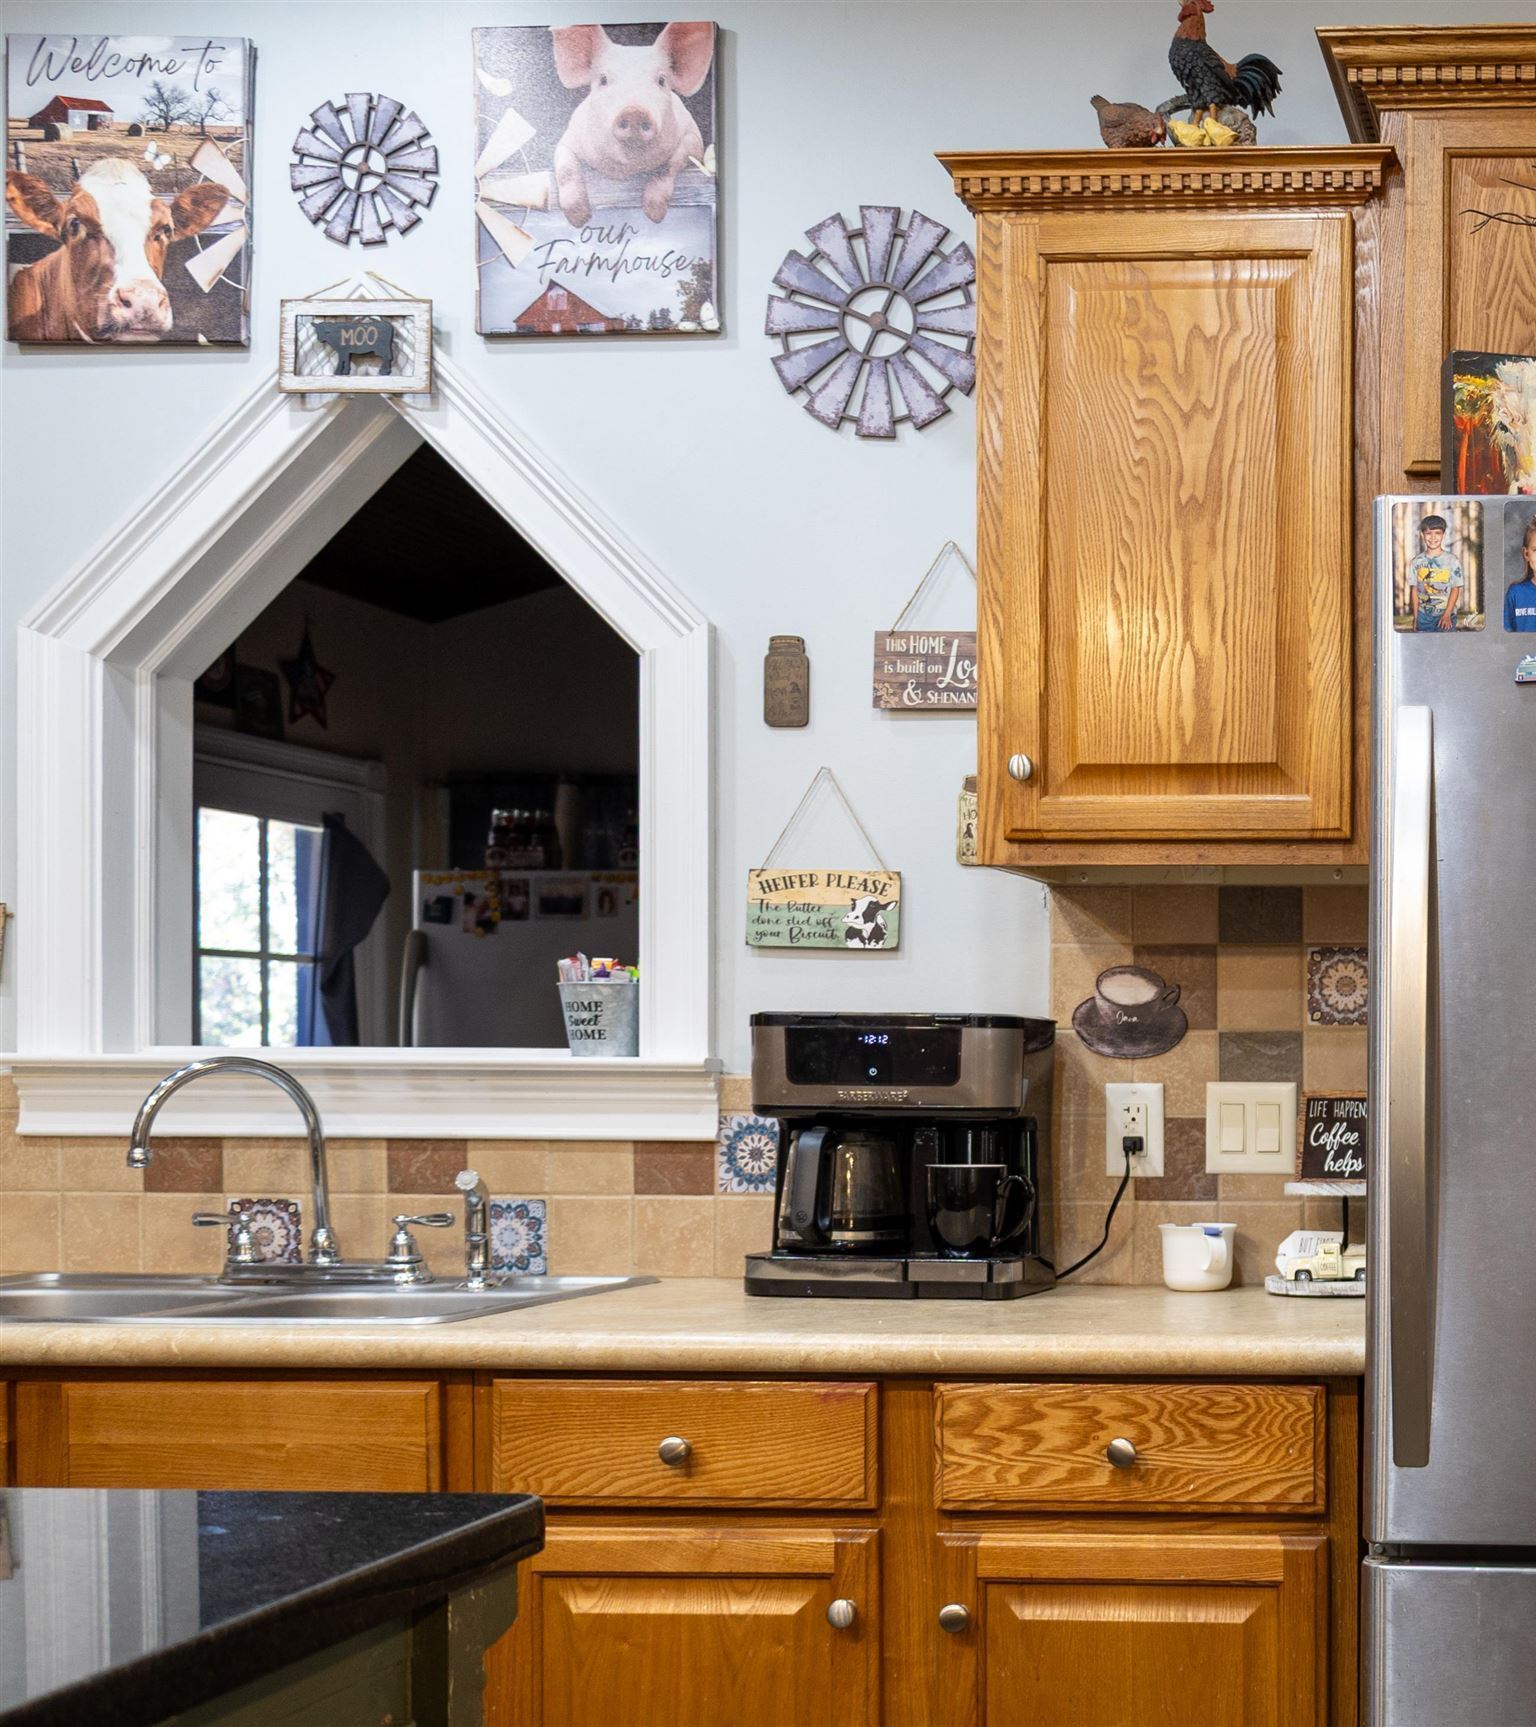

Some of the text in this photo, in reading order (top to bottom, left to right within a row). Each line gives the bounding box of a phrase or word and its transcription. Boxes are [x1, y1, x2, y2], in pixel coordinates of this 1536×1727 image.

[26, 36, 226, 92] Welcome to
[580, 222, 640, 245] our
[534, 239, 697, 285] Farmhouse
[341, 326, 378, 346] MOO
[885, 635, 947, 655] THIS HOME
[884, 661, 894, 674] is
[896, 659, 925, 674] built
[927, 664, 942, 673] on
[903, 679, 977, 706] & SHENAN
[758, 873, 893, 897] HEIFER PLEASE
[752, 898, 782, 914] The
[752, 915, 839, 928] done slid off
[753, 929, 783, 942] your
[565, 1001, 603, 1012] HOME
[568, 1013, 602, 1026] Sweet
[569, 1029, 607, 1040] HOME
[1309, 1100, 1367, 1119] LIFE HAPPEN
[1324, 1149, 1365, 1178] helps
